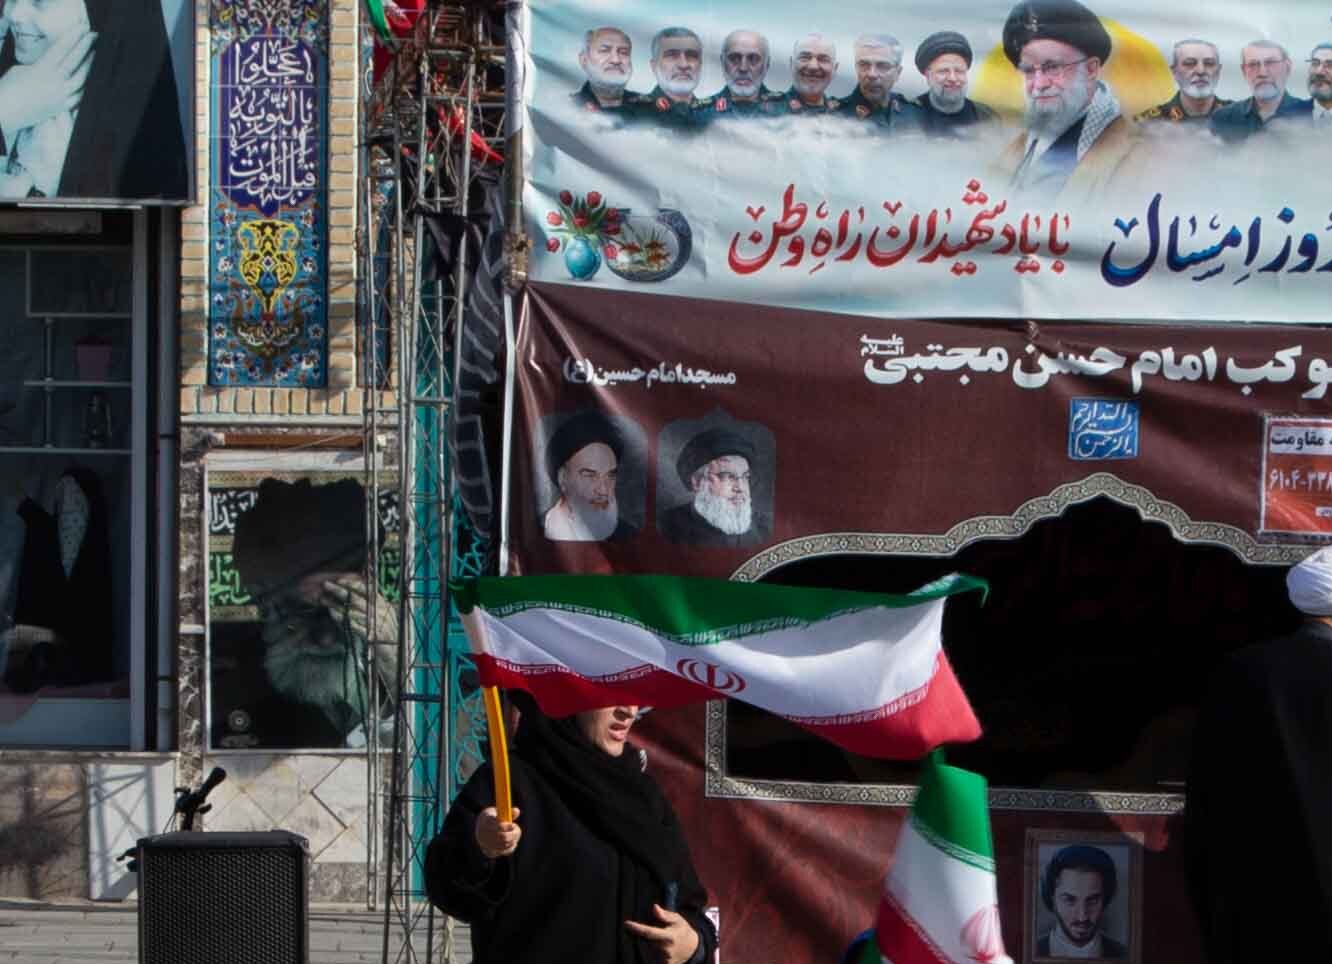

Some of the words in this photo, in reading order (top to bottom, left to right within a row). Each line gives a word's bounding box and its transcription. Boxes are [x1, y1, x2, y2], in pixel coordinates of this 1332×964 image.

[728, 183, 809, 275] وطن
[866, 179, 1006, 276] شهیدان
[1101, 193, 1262, 288] امسال
[593, 367, 647, 386] حسین
[645, 361, 687, 389] امام
[687, 368, 737, 390] مسجد
[863, 346, 1009, 385] مجتبی
[1012, 344, 1127, 389] حسن
[1131, 346, 1218, 394] امام
[1271, 430, 1325, 450] مقاومت
